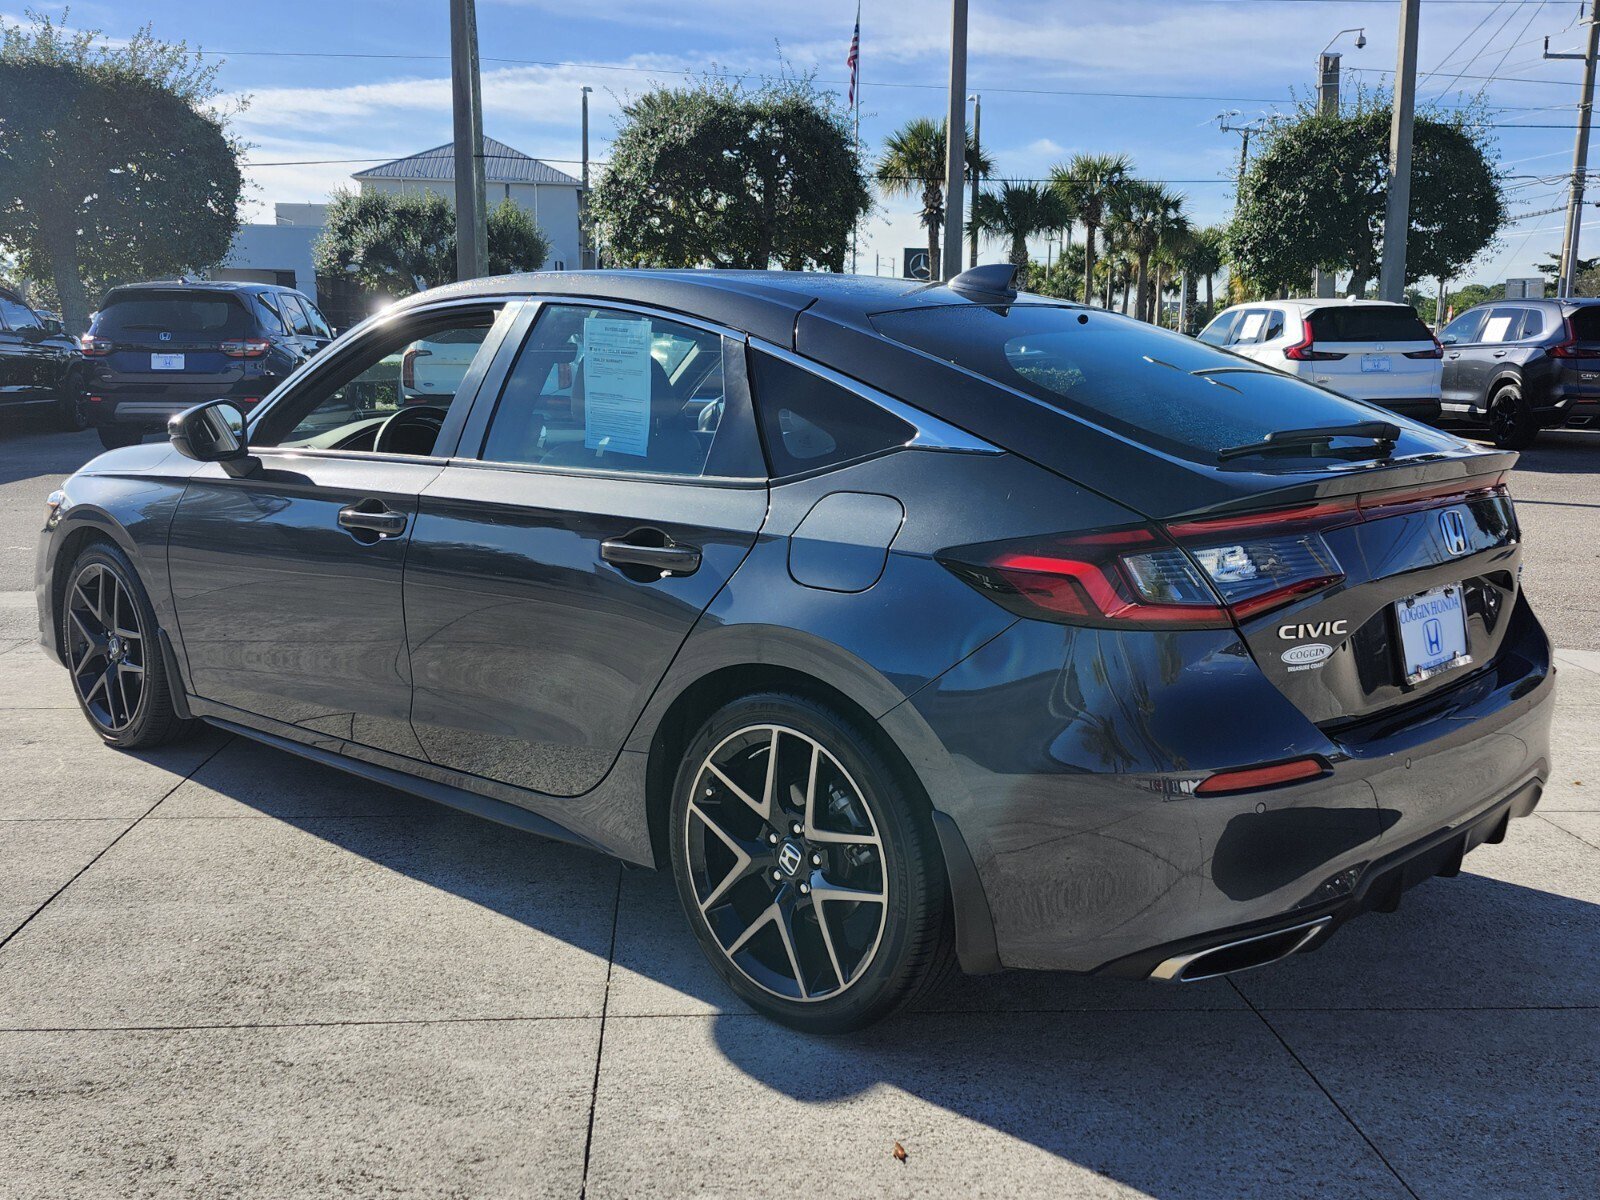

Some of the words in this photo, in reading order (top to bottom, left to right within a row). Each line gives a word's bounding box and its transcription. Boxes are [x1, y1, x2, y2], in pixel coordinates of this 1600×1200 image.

[1400, 602, 1431, 624] COGGIN
[1430, 596, 1460, 616] HONDA
[1278, 619, 1348, 640] CIVIC
[1289, 647, 1326, 660] COGGIN
